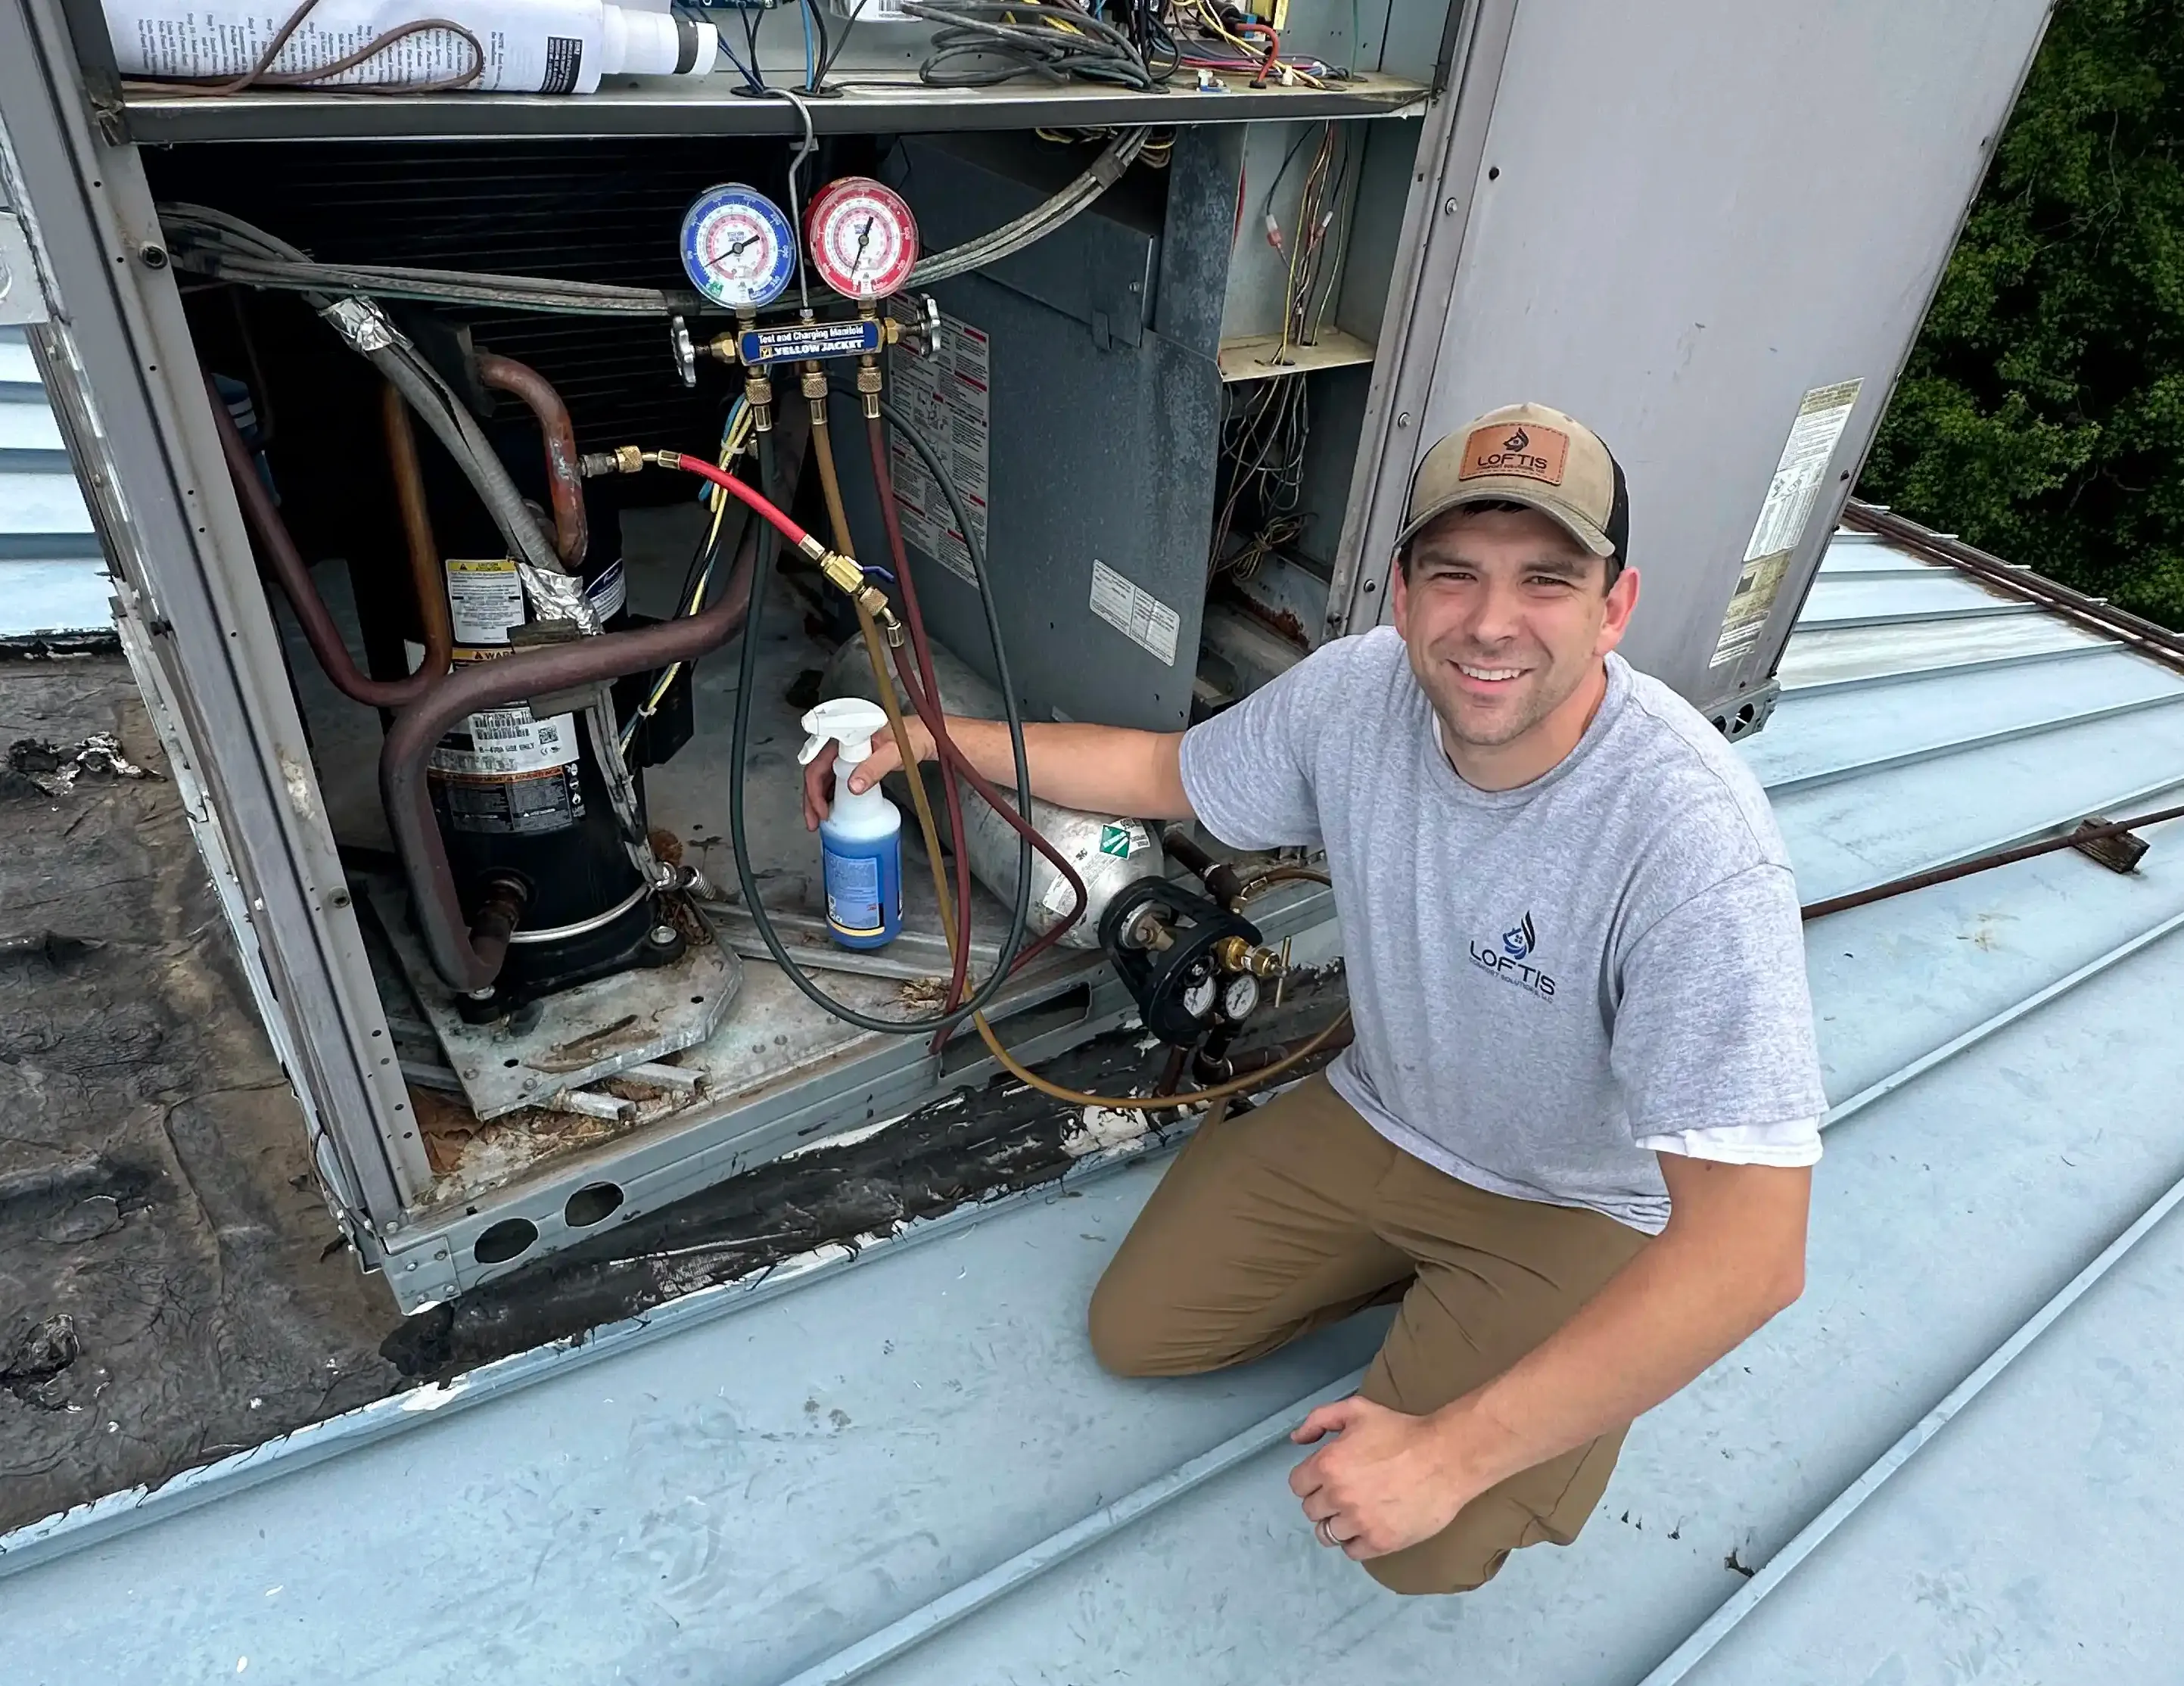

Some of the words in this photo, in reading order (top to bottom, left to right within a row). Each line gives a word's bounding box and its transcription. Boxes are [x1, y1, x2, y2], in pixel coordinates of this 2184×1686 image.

[758, 334, 775, 344] Test
[776, 332, 792, 343] and
[793, 328, 829, 341] Charging
[830, 325, 863, 338] Manifold
[773, 344, 820, 356] YELLOW
[821, 339, 864, 352] JACKET
[1477, 453, 1548, 469] LOFTIS
[1470, 940, 1556, 996] LOFTIS
